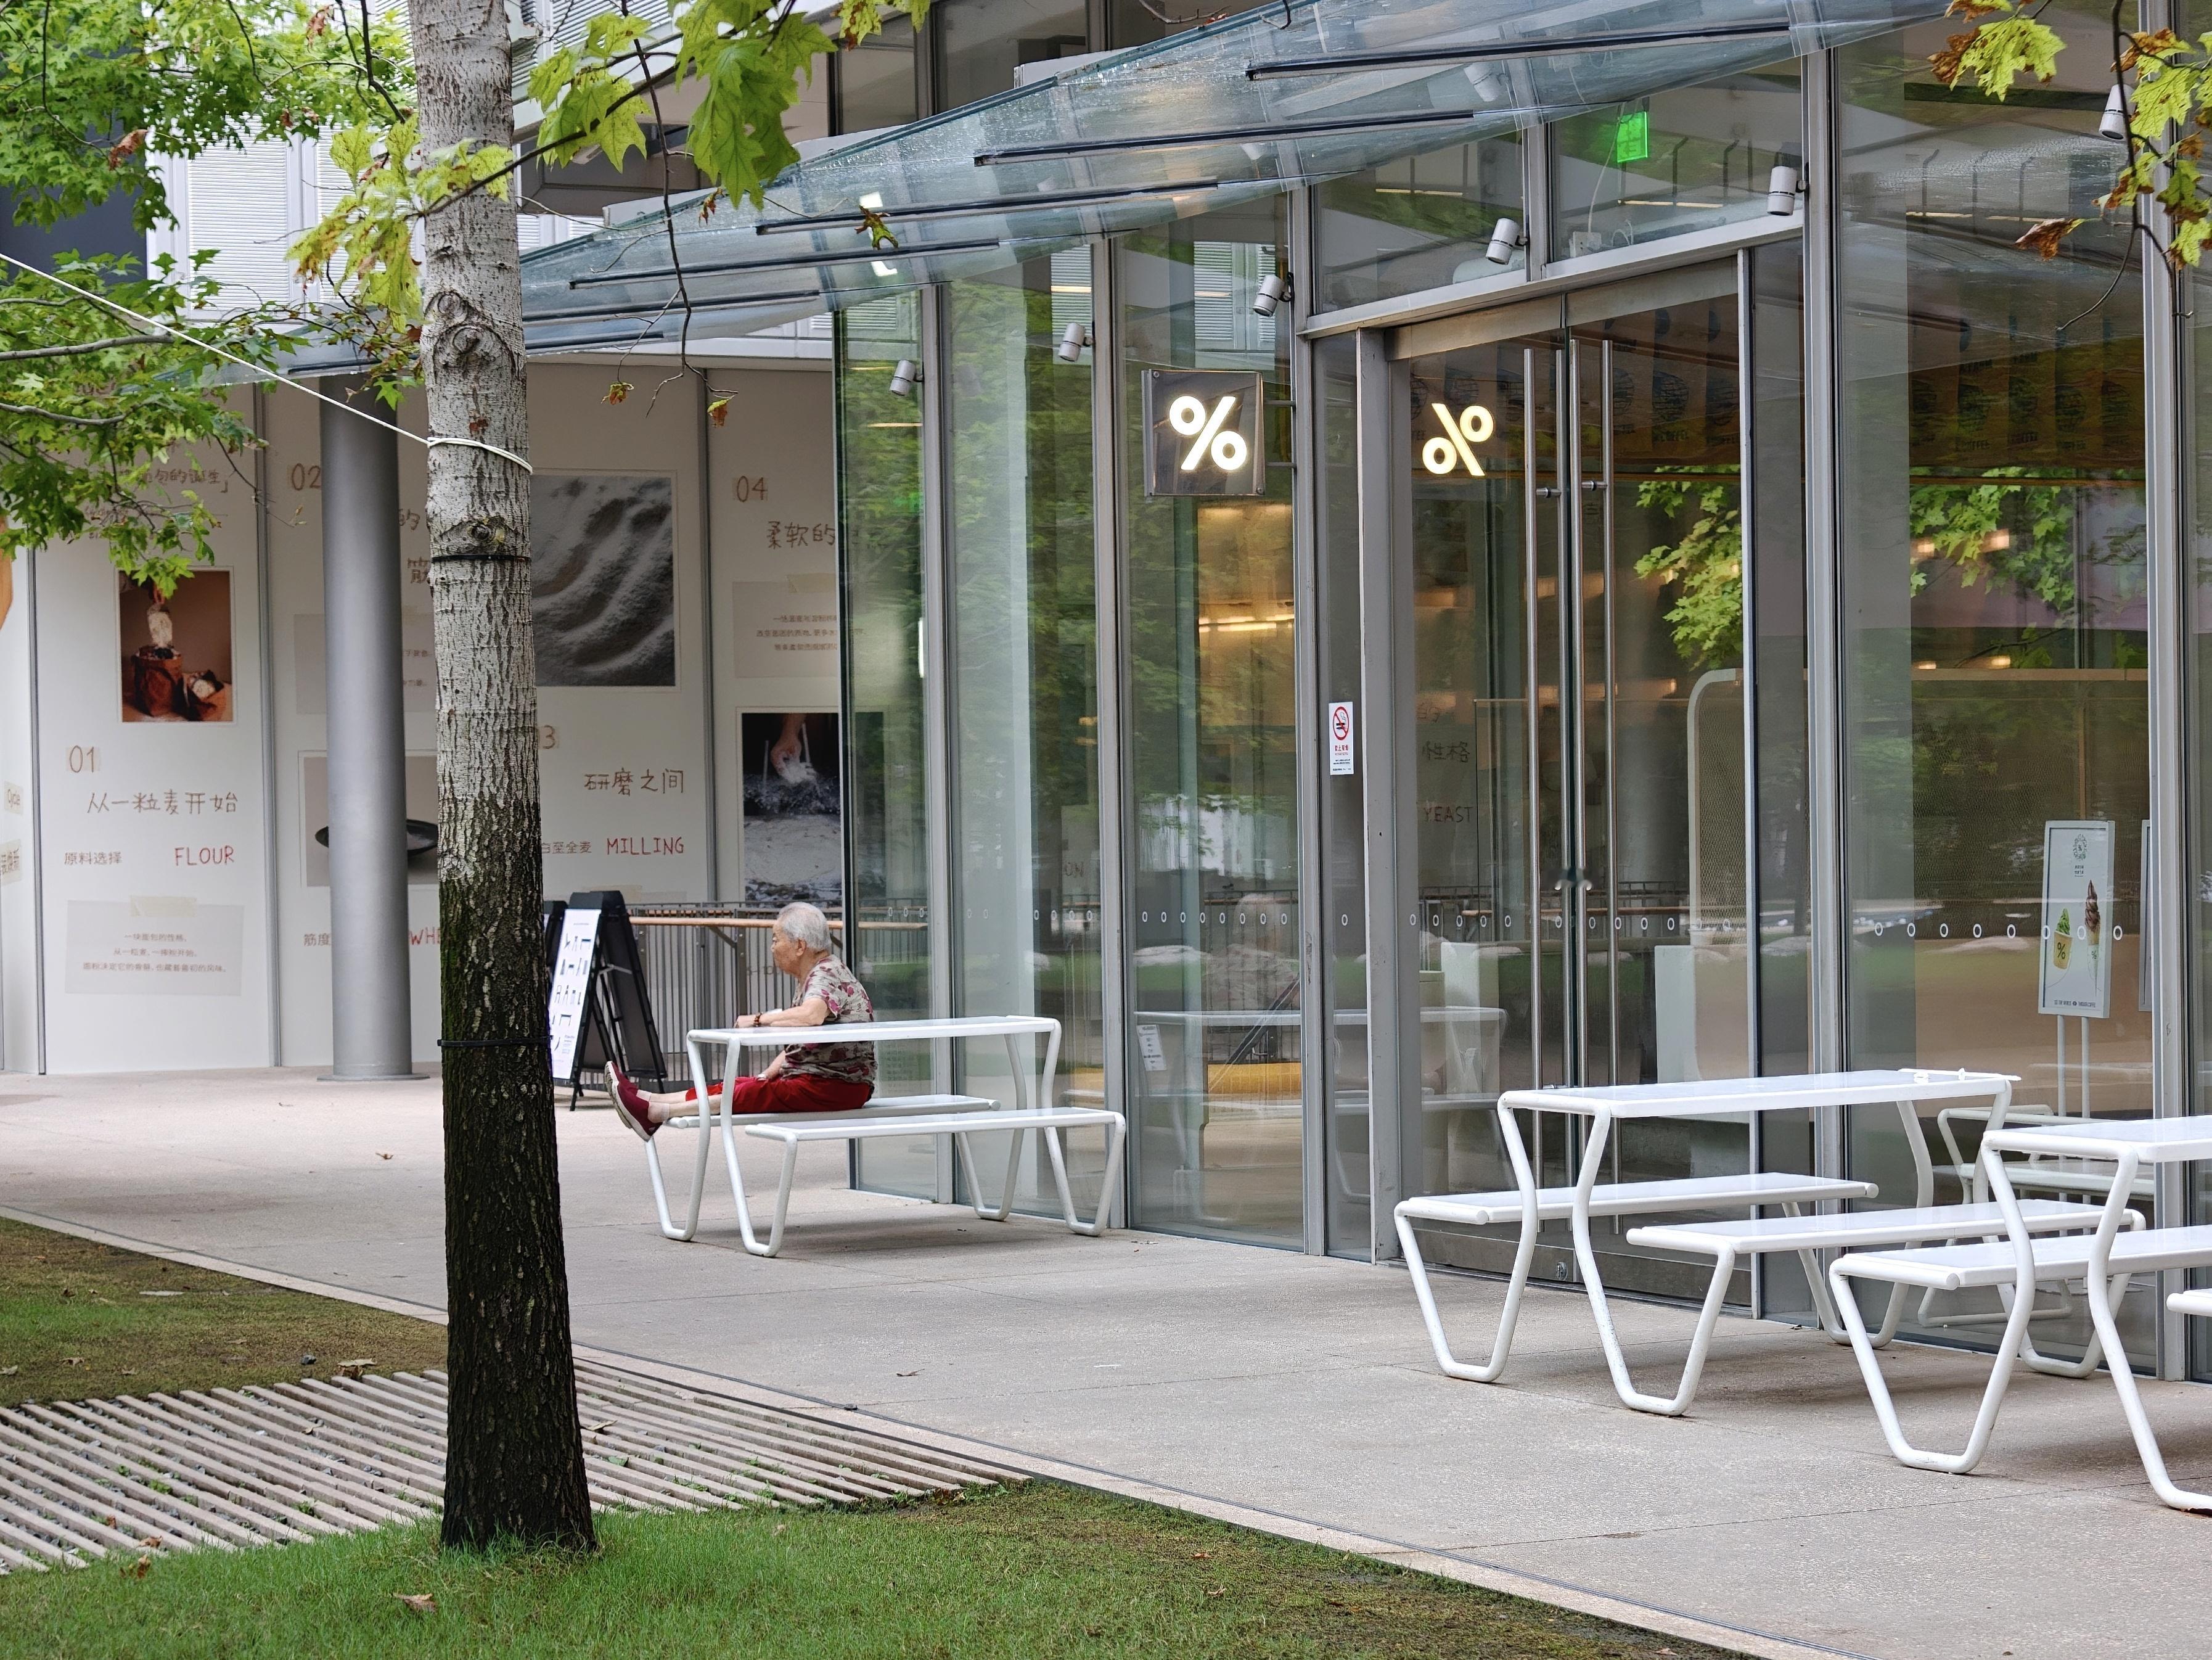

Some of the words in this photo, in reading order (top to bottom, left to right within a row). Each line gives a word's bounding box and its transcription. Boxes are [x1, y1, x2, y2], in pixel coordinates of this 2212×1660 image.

[1168, 395, 1248, 471] %
[291, 462, 321, 491] 02
[737, 475, 768, 503] 04
[766, 520, 835, 549] 柔软的
[538, 725, 555, 749] 3
[69, 745, 94, 773] 01
[584, 767, 684, 797] 研磨之间
[86, 789, 238, 815] 从一粒麦开始
[1423, 805, 1474, 824] YEAST
[64, 850, 123, 865] 原料选择
[174, 845, 235, 866] FLOUR
[607, 836, 684, 855] MILLING
[409, 927, 440, 945] WH
